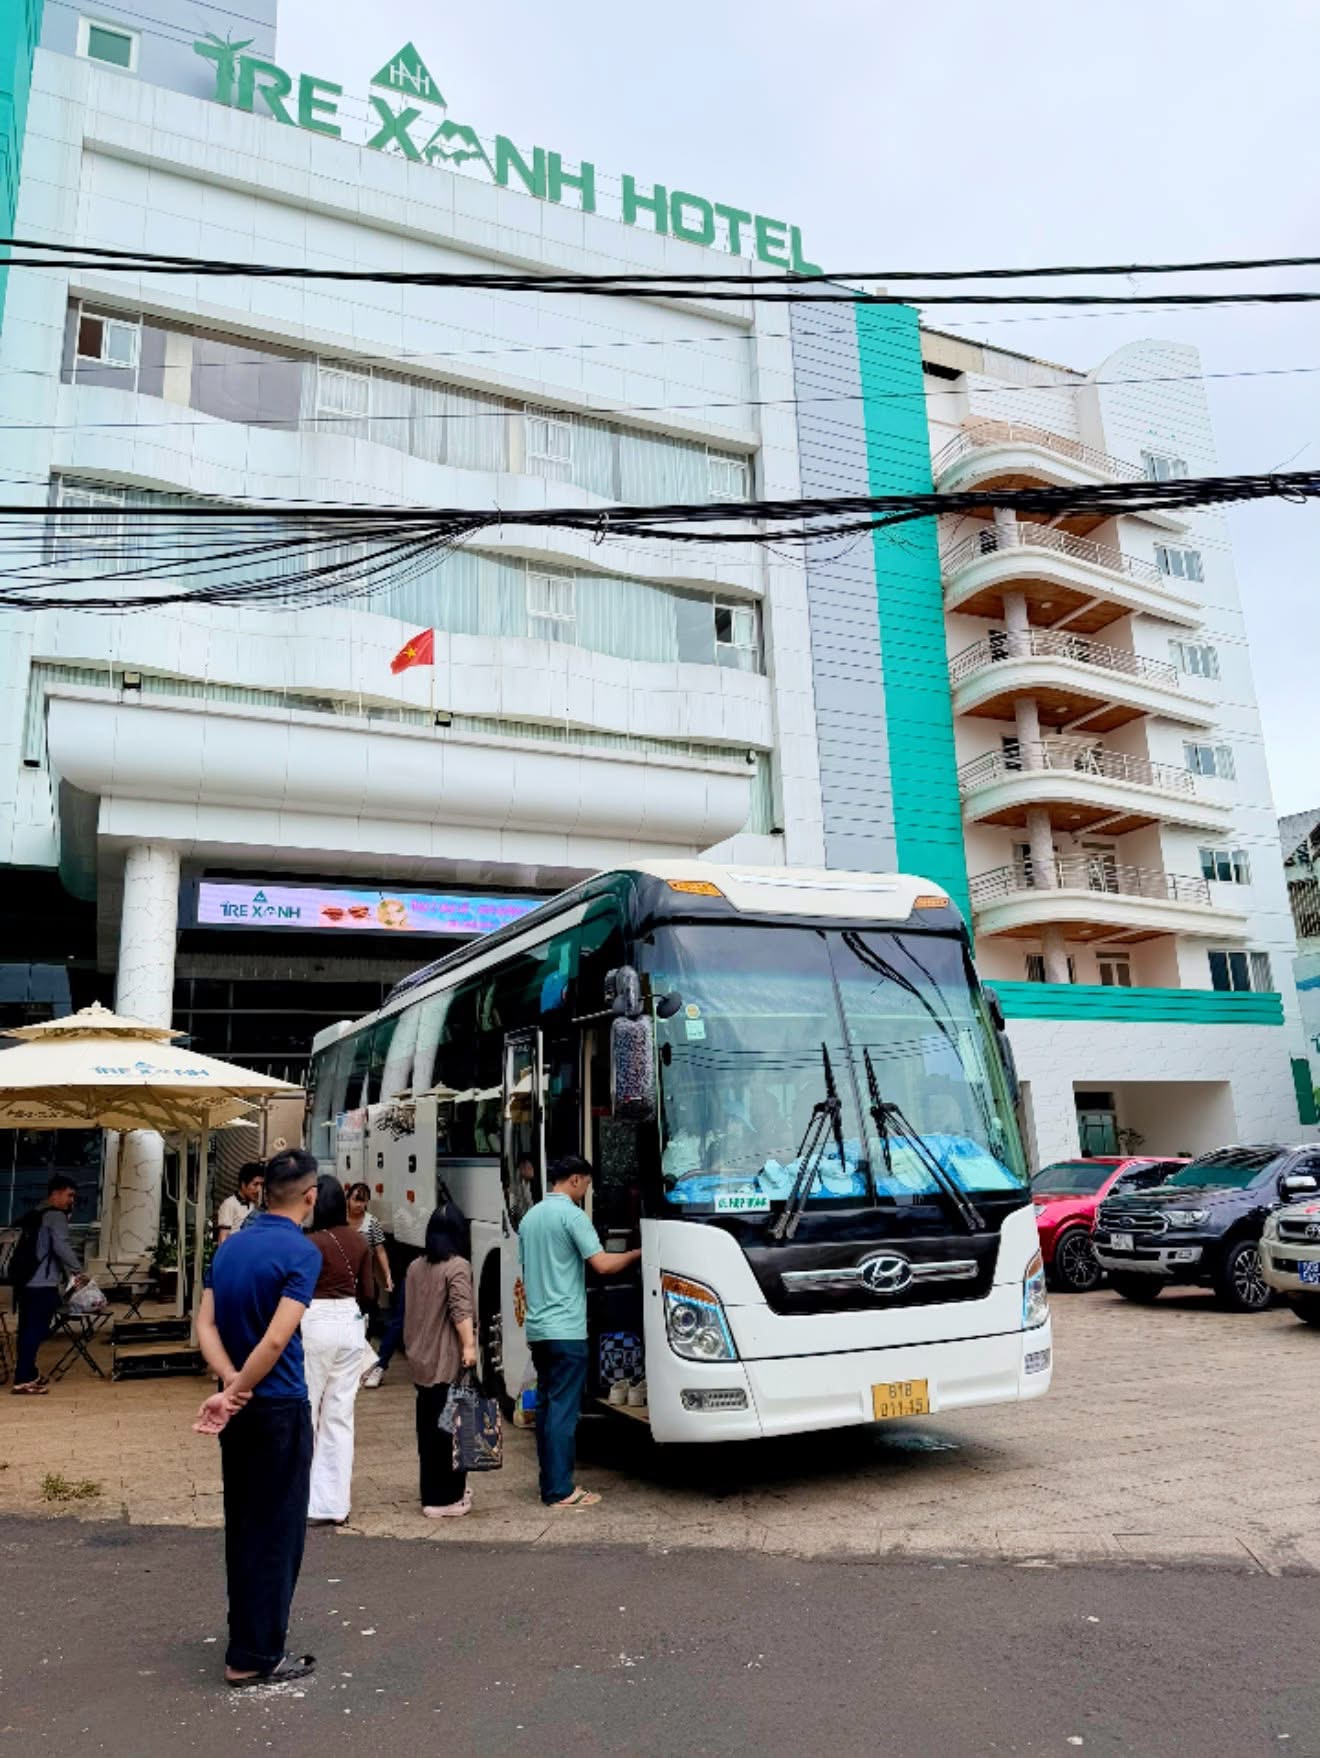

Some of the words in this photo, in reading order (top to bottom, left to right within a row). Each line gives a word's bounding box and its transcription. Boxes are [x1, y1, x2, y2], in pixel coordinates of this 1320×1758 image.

[193, 32, 343, 139] TRE
[366, 94, 595, 214] XANH
[621, 173, 824, 277] HOTEL
[219, 901, 249, 918] TRE
[252, 905, 301, 919] XANH
